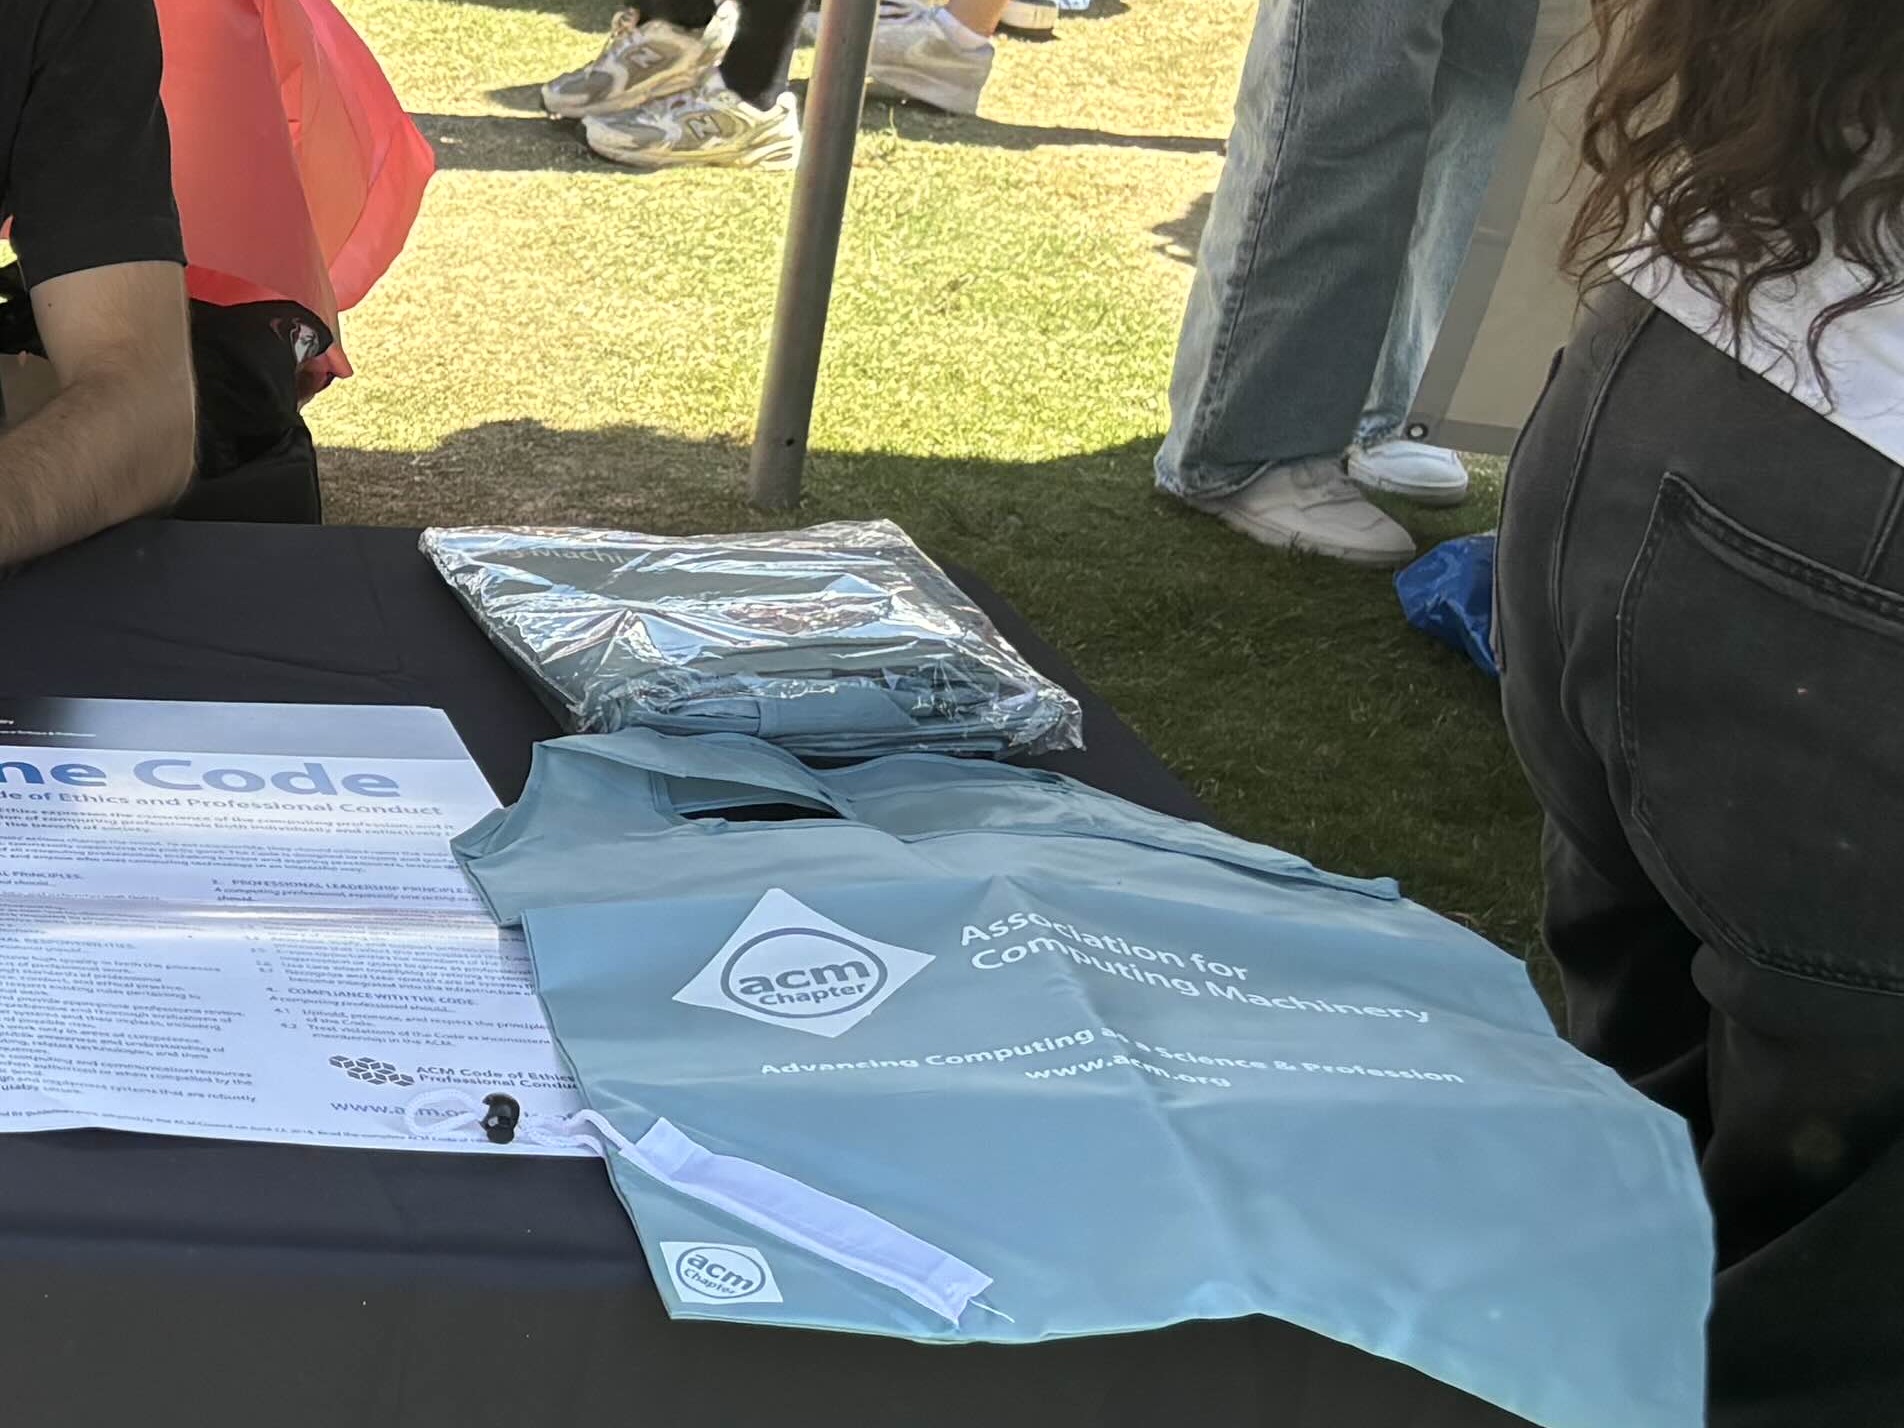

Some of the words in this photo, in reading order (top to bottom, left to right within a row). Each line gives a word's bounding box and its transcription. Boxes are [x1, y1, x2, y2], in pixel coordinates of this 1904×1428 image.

[132, 758, 402, 798] Code
[28, 790, 52, 802] of
[60, 791, 130, 806] Ethics
[135, 794, 182, 807] and
[187, 797, 334, 814] Professional
[338, 802, 444, 817] Conduct
[960, 910, 1186, 970] Association
[1190, 952, 1249, 983] for
[738, 959, 871, 996] acm
[758, 981, 867, 1006] Chapter
[970, 934, 1202, 998] Computing
[1205, 979, 1432, 1024] Machinery
[416, 1065, 456, 1076] ACM
[459, 1067, 504, 1079] Code
[507, 1069, 525, 1080] of
[761, 1058, 920, 1075] Advancing
[925, 1027, 1095, 1067] Computing
[1156, 1045, 1268, 1070] Science
[1301, 1061, 1466, 1085] Profession
[1024, 1053, 1233, 1088] www.acm.org
[418, 1074, 517, 1088] Professional
[683, 1267, 736, 1295] Chapter
[687, 1253, 755, 1292] acm
